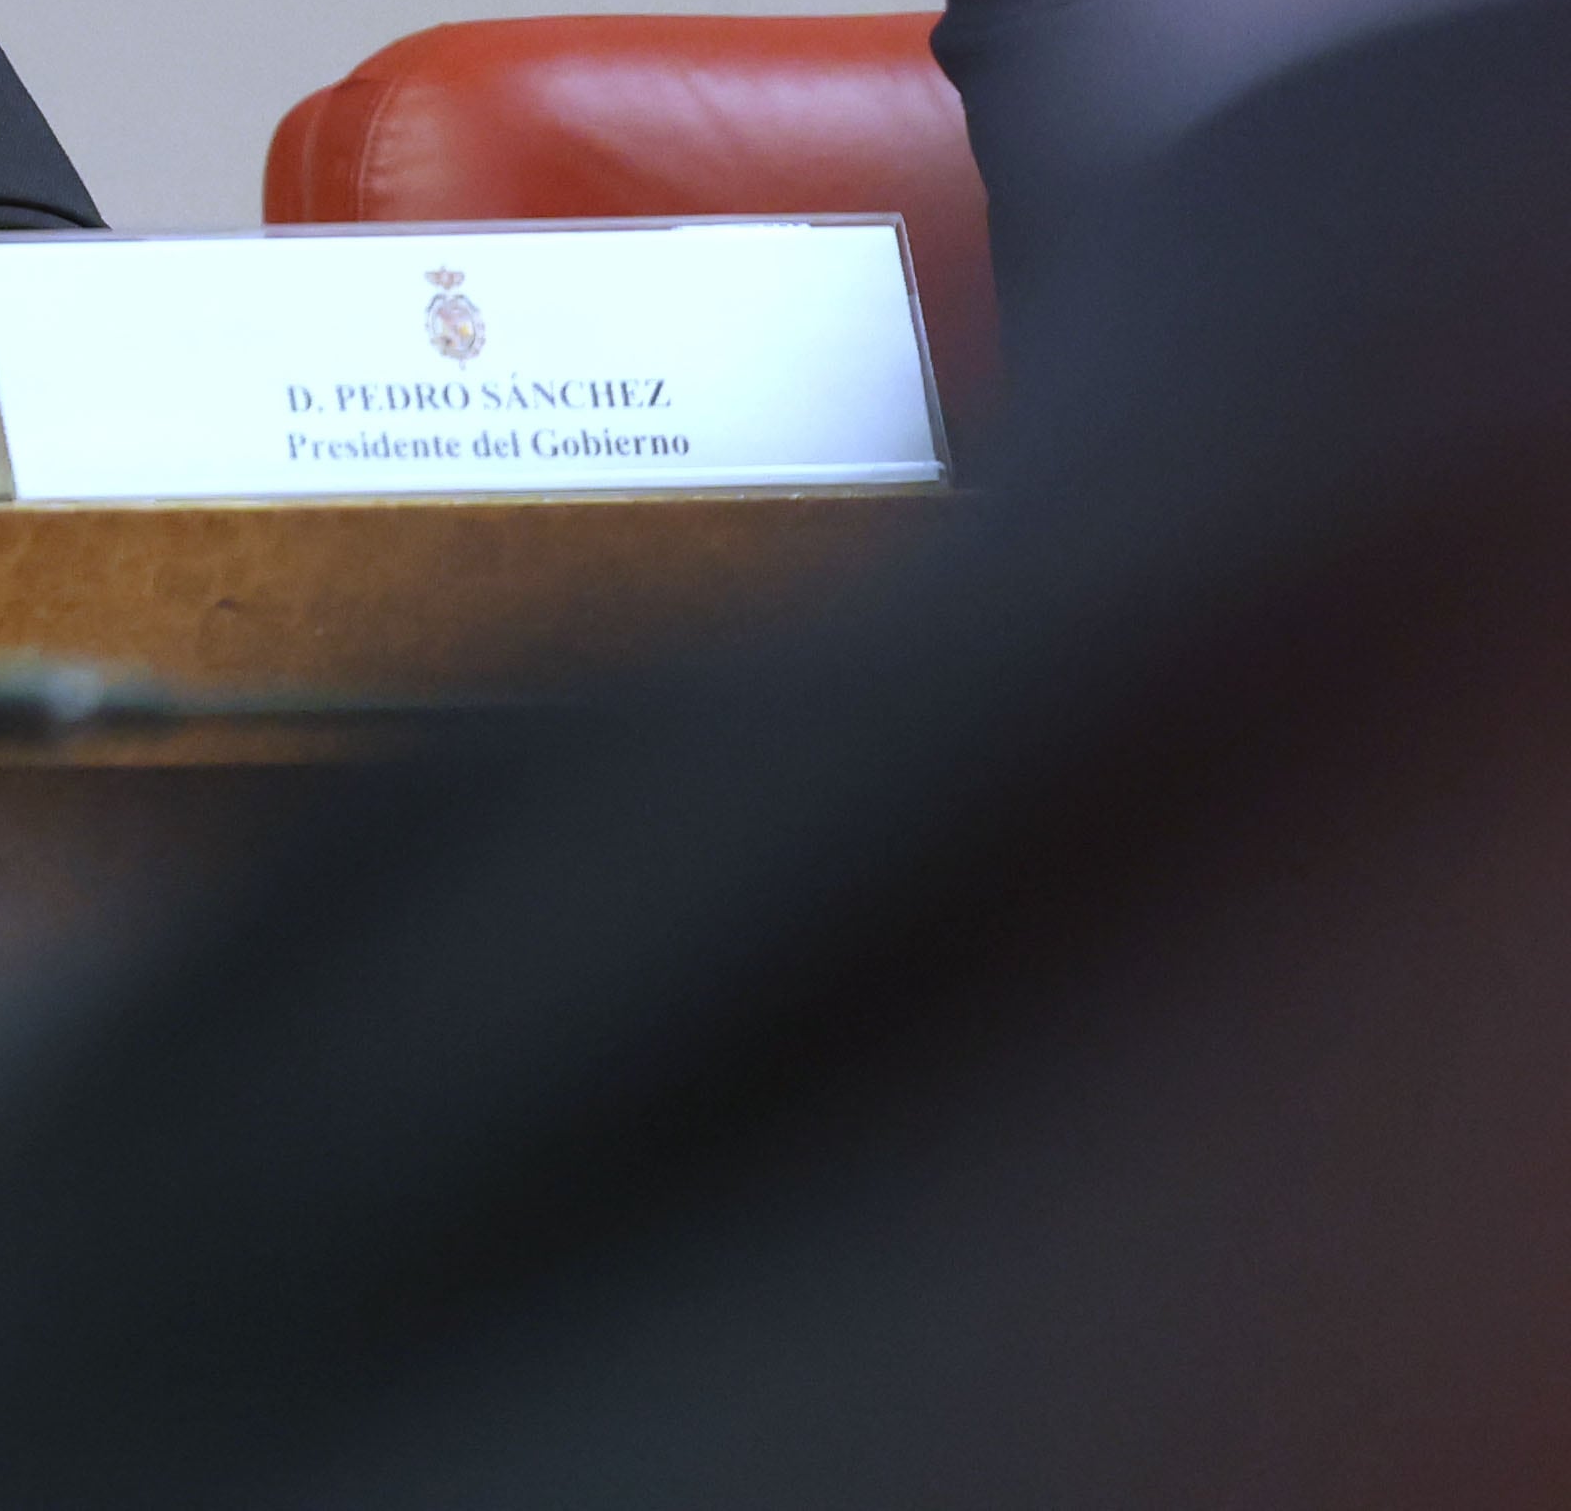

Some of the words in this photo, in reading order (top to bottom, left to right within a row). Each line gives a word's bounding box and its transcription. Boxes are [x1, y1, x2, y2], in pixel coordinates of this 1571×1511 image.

[286, 383, 325, 414] D.
[334, 380, 471, 413] PEDRO
[479, 373, 672, 411] SÁNCHEZ
[286, 431, 461, 461] Presidente
[471, 428, 521, 459] del
[530, 426, 691, 458] Gobierno
